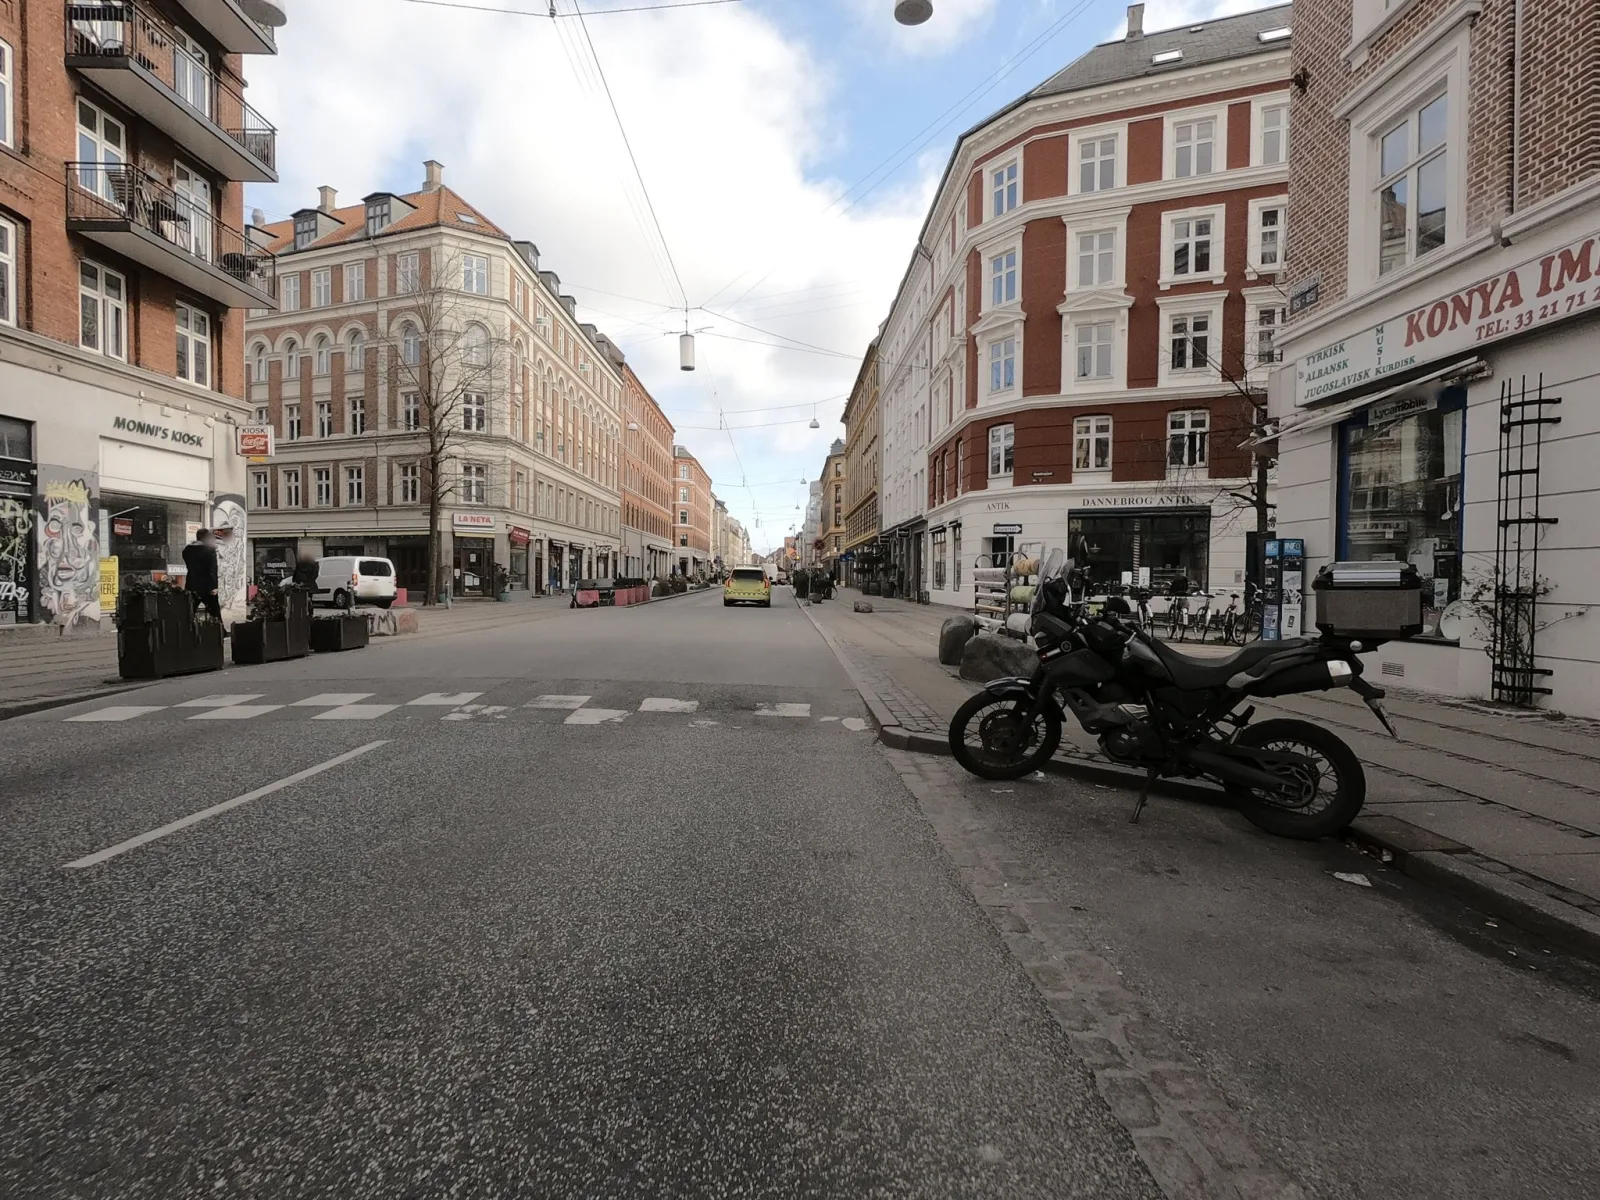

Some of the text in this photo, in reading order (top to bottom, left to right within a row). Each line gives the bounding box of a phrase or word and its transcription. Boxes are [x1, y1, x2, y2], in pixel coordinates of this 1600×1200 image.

[1404, 237, 1600, 347] KONYA IM
[1475, 319, 1509, 341] TEL:
[1514, 310, 1533, 331] 33
[1539, 300, 1559, 320] 21
[1565, 291, 1587, 312] 71
[1305, 342, 1345, 366] TYRKISK
[1304, 355, 1416, 399] JUGOSLAVISK KURDISK
[1305, 358, 1349, 383] ALBANSK
[1374, 398, 1428, 420] Lycamobile
[113, 416, 203, 448] MONNI'S KIOSK
[987, 501, 1010, 511] ANTIK
[1082, 495, 1194, 507] DANNEBROG ANTIK
[1284, 542, 1301, 550] INFO
